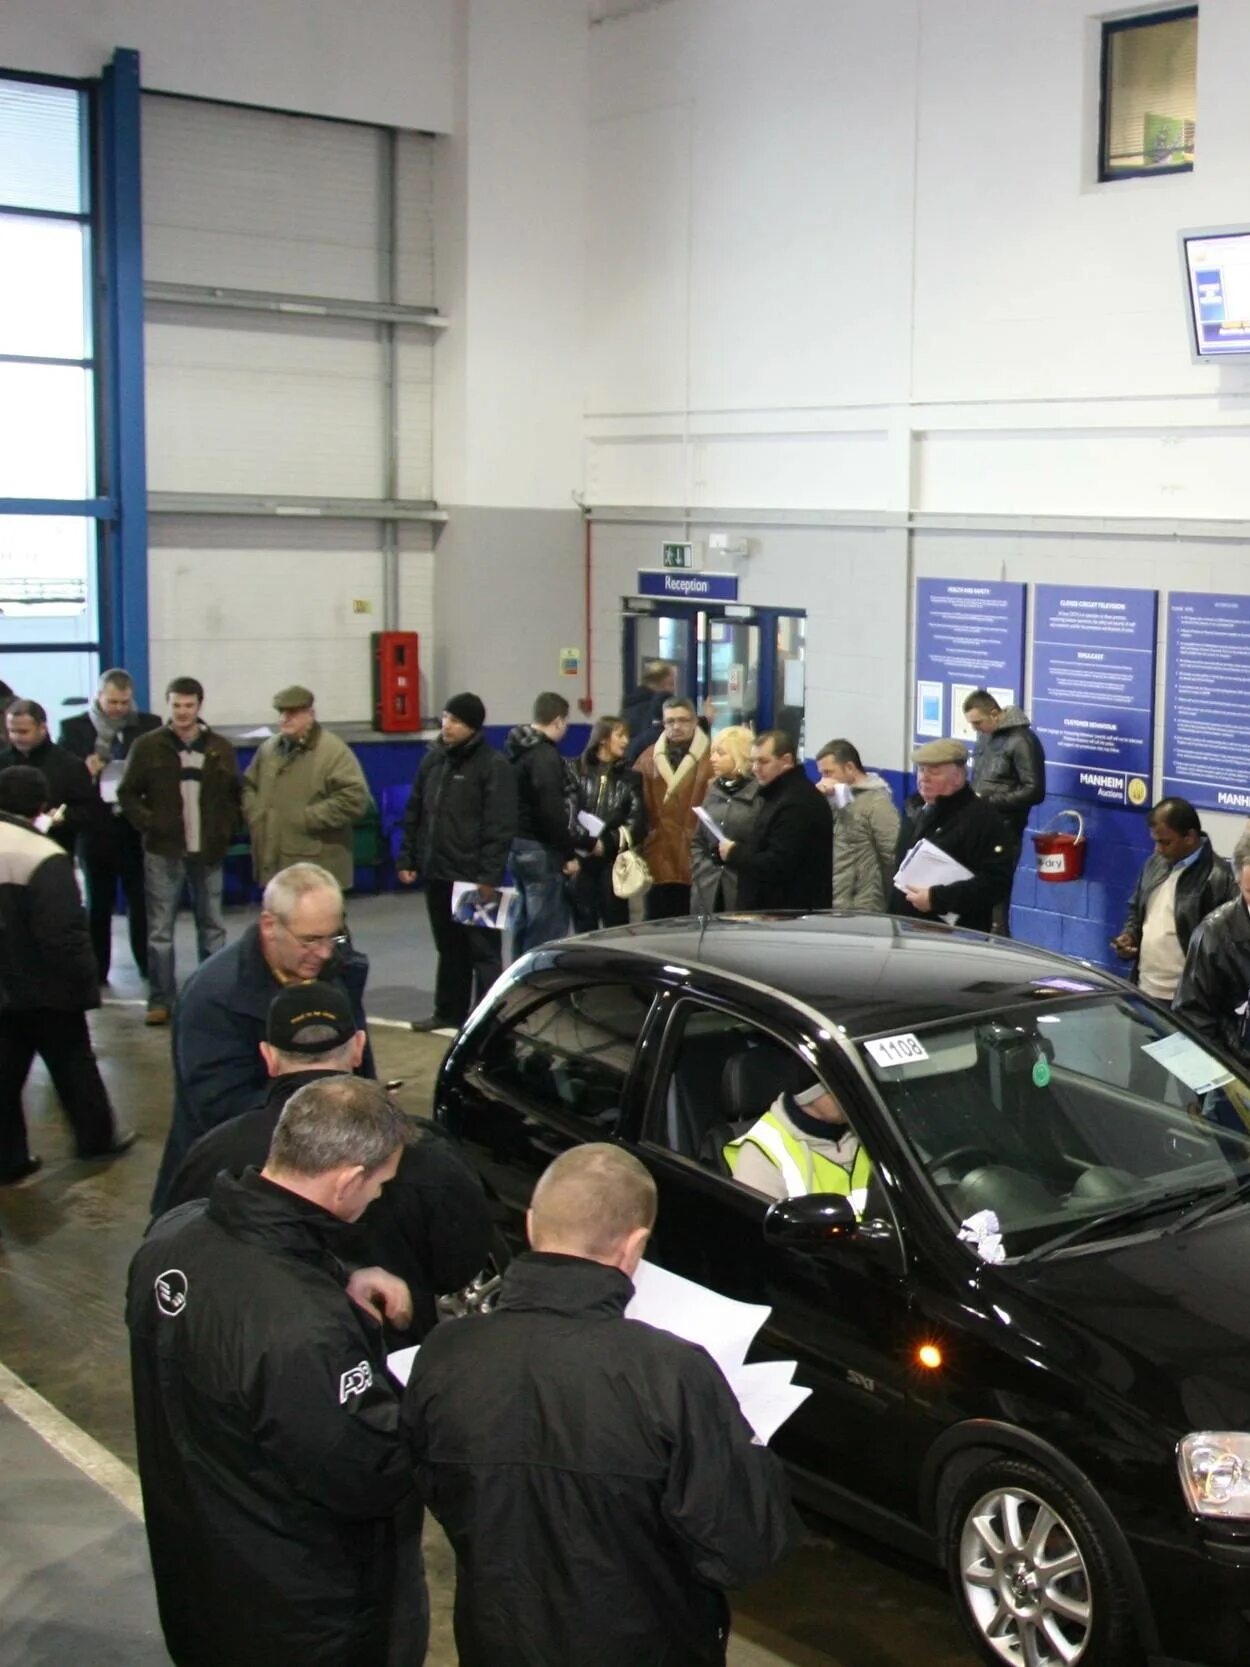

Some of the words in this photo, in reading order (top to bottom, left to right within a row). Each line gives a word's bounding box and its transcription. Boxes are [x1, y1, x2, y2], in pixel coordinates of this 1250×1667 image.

[664, 575, 708, 595] Reception
[1079, 773, 1124, 789] MANHEIM
[879, 1038, 922, 1060] 1108
